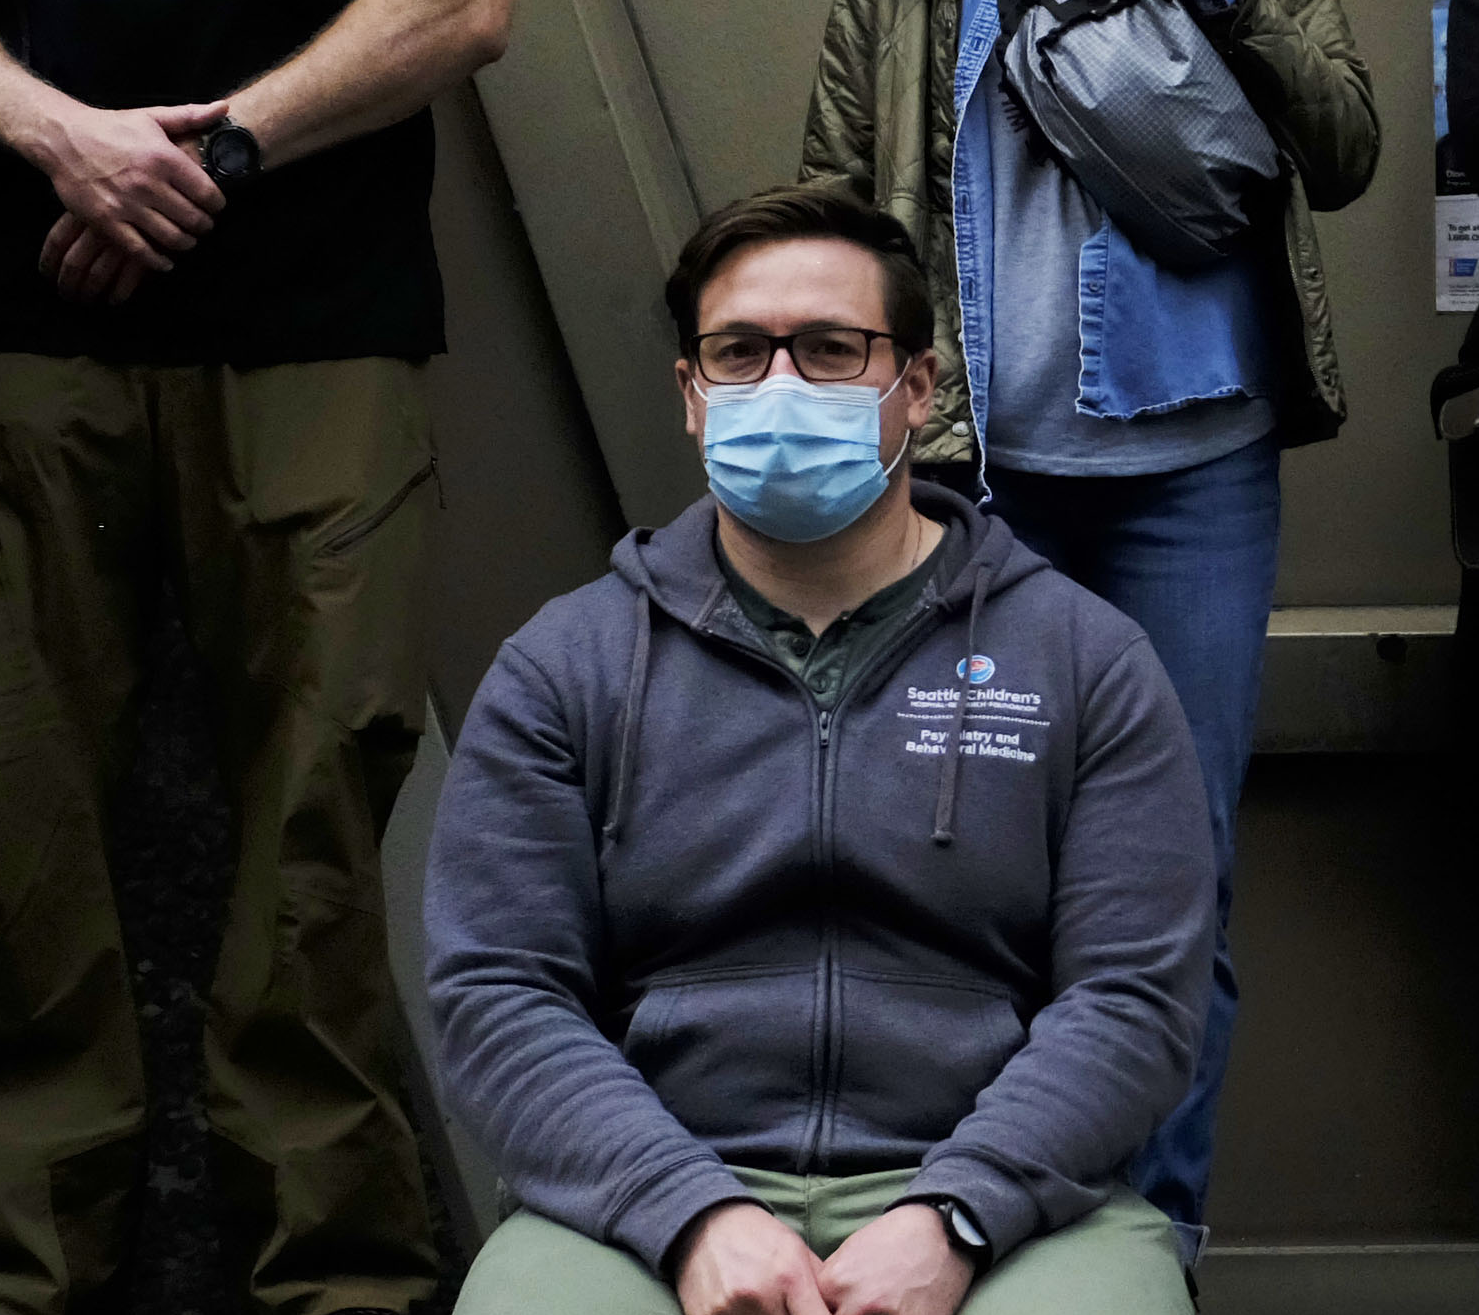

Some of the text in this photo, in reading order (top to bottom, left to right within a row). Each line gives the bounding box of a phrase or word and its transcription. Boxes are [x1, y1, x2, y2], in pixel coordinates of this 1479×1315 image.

[908, 687, 1041, 704] Seattle Children's
[996, 733, 1020, 745] and
[979, 743, 1036, 762] Medicine
